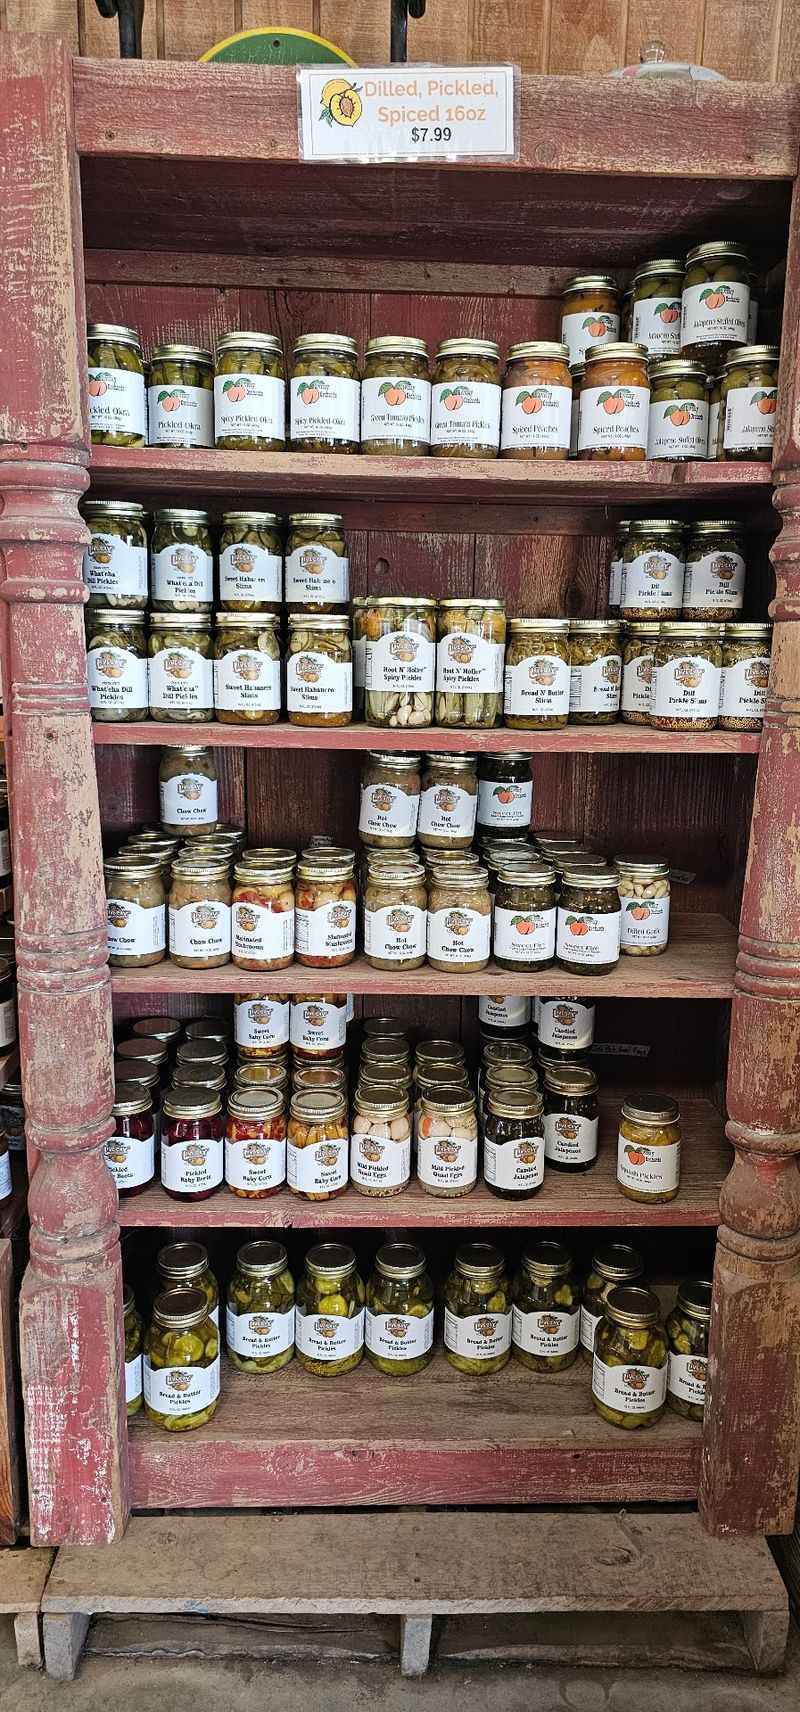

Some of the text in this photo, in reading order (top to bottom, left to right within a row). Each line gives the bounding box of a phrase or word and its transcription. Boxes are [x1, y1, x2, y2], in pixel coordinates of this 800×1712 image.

[364, 80, 499, 99] Dilled, Pickled,
[378, 106, 487, 126] Spiced 16oz
[411, 127, 452, 143] $7.99
[556, 1140, 580, 1148] Candied
[516, 1165, 537, 1174] Candied
